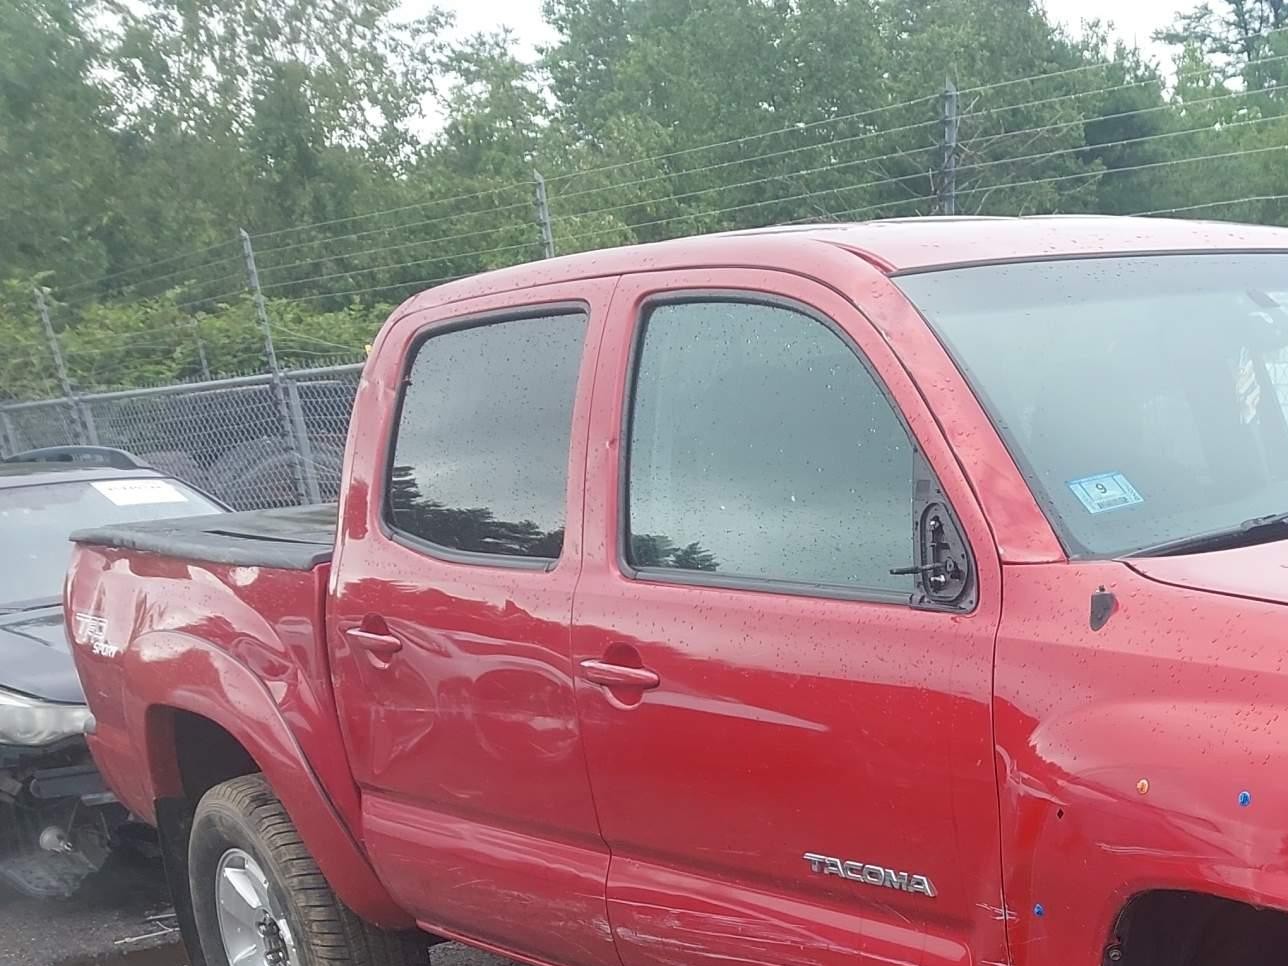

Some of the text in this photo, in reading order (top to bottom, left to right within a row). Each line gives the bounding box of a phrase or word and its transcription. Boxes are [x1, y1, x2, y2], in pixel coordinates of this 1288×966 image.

[1095, 483, 1107, 494] 9
[75, 612, 108, 645] TRD
[92, 641, 119, 658] SPORT
[803, 852, 938, 897] TACOMA
